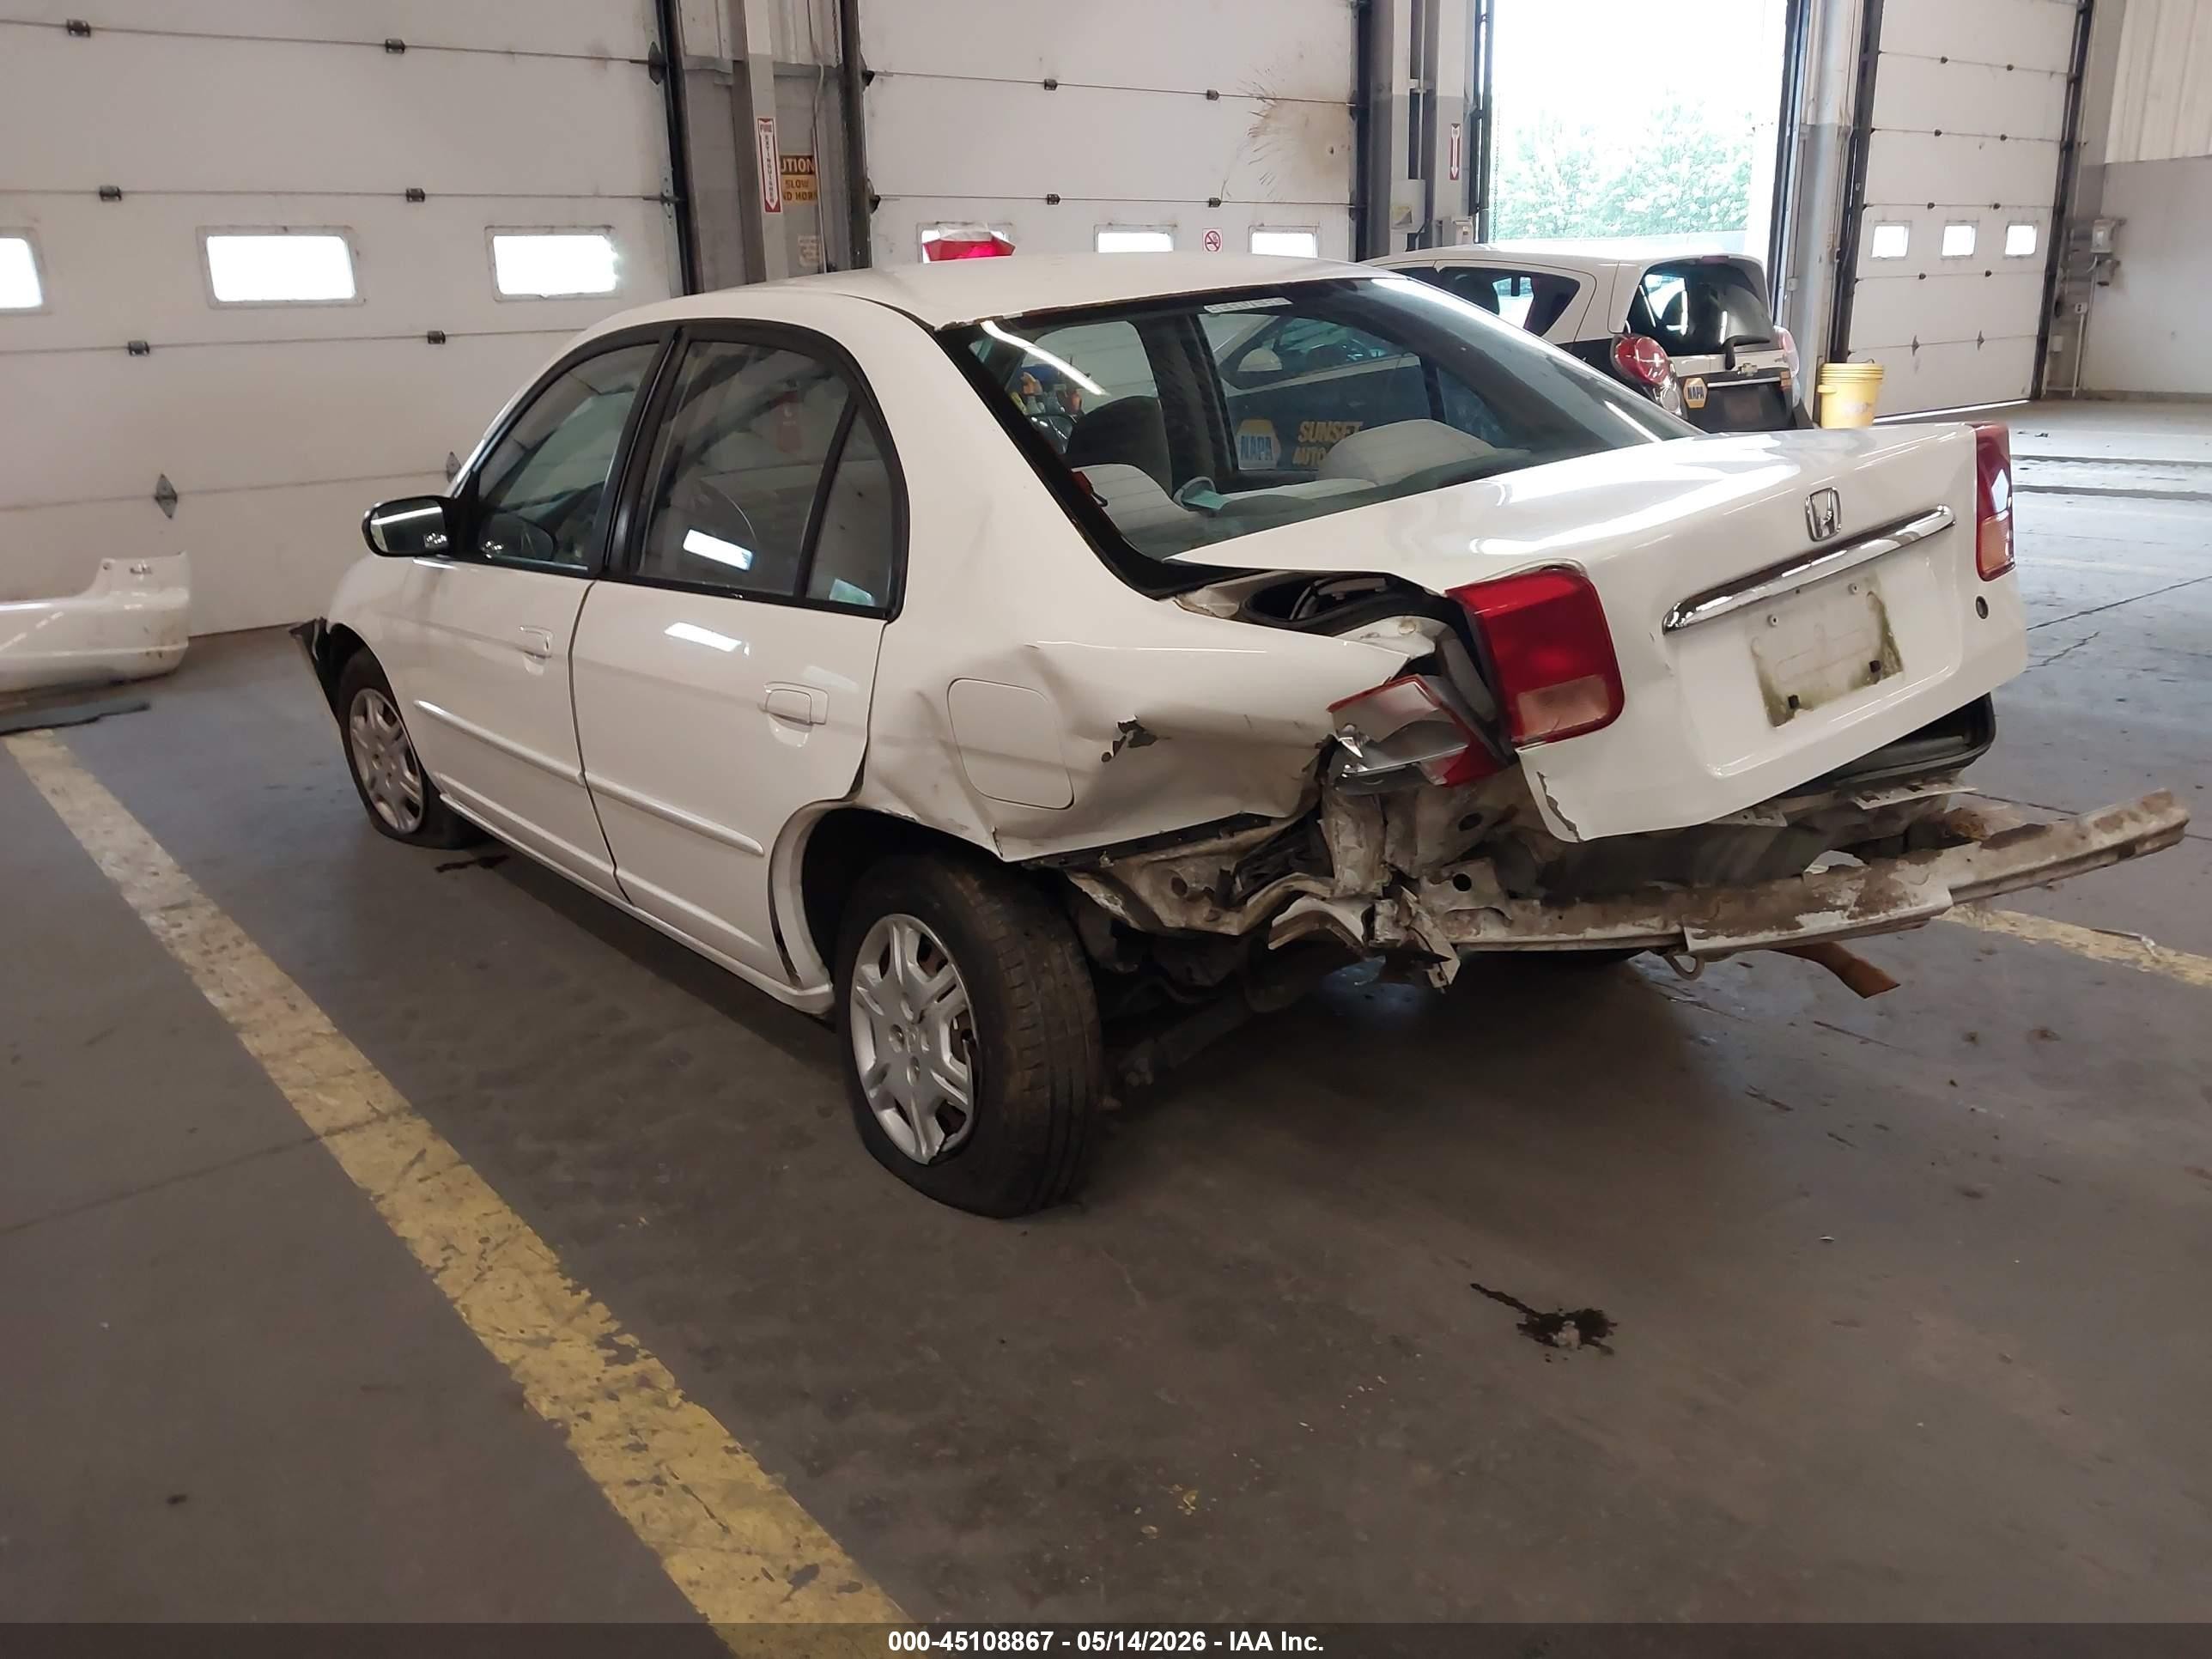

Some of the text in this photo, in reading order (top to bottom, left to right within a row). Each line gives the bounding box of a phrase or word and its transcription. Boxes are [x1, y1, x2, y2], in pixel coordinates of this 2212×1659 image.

[785, 179, 810, 189] SLOW
[1686, 386, 1705, 399] NAPA
[1240, 435, 1273, 461] NAPA
